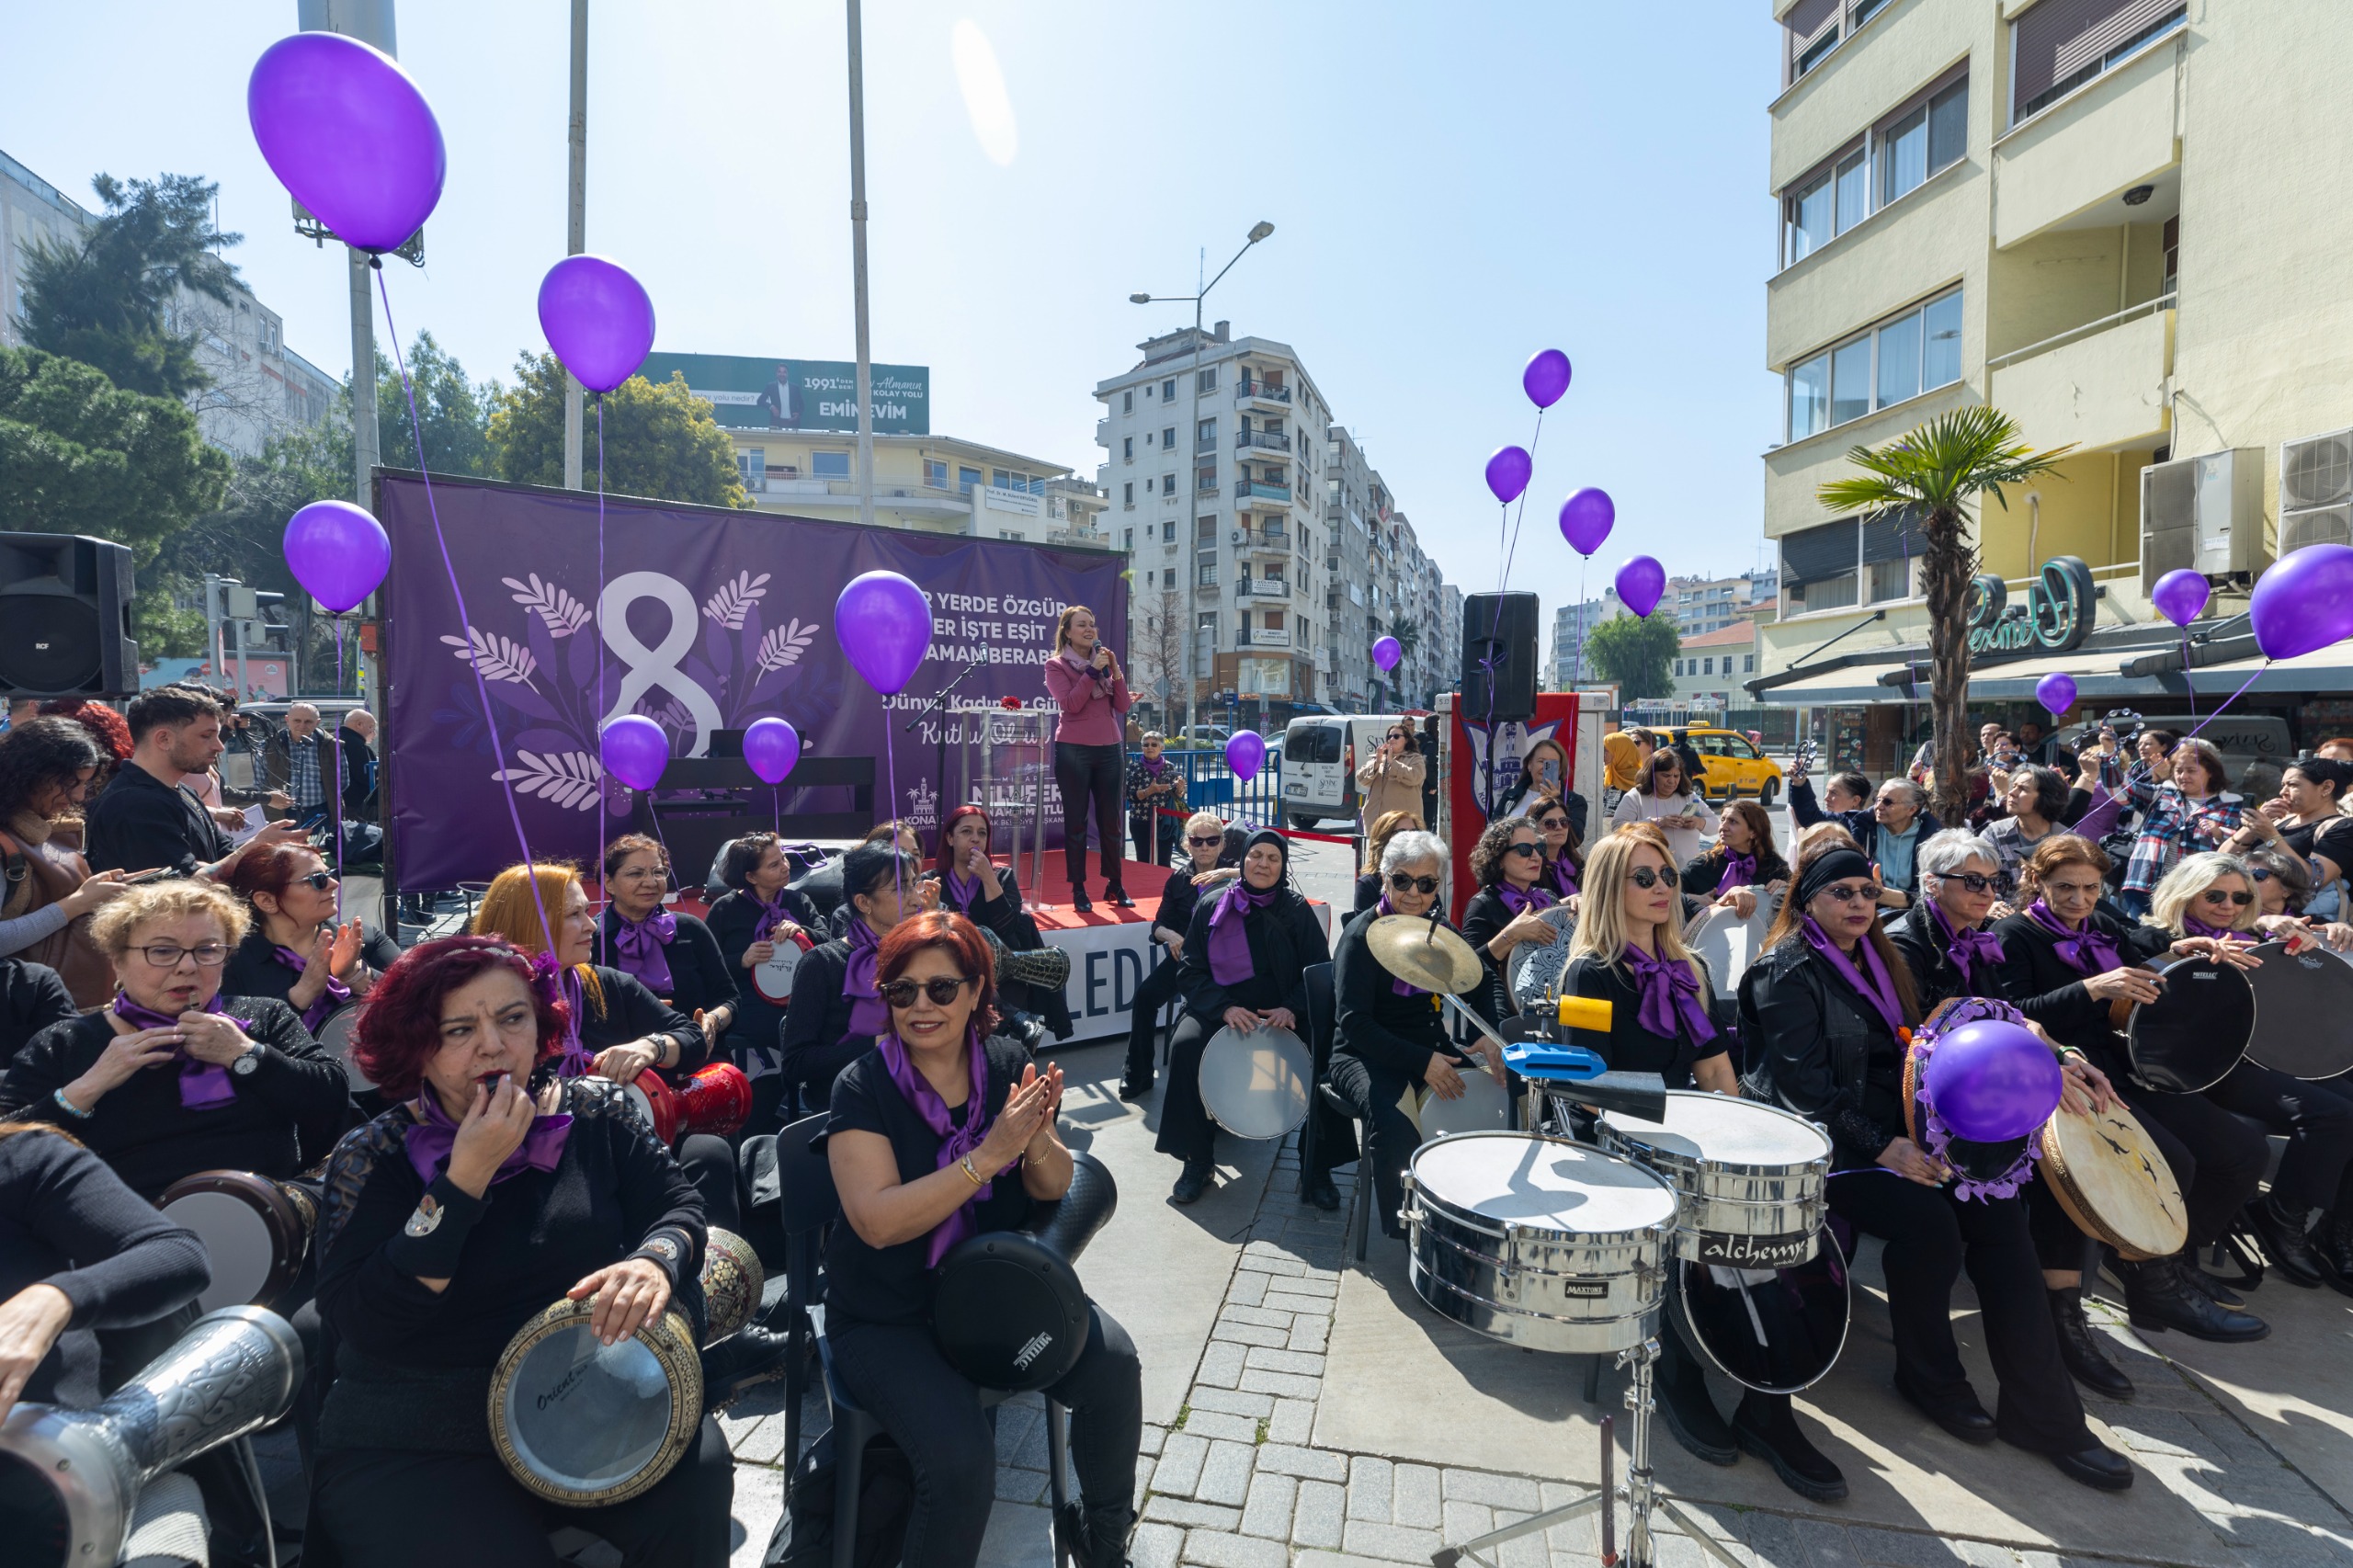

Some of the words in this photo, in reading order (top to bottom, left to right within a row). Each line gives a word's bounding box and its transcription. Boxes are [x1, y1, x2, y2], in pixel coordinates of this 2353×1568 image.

[877, 376, 923, 392] Almanın
[902, 391, 923, 399] YOLU
[713, 393, 730, 403] yolu
[732, 394, 755, 403] nedir?
[937, 593, 998, 614] YERDE
[1003, 595, 1067, 618] ÖZGÜR
[933, 618, 957, 637] ER
[961, 616, 1003, 642] İŞTE
[1007, 619, 1047, 643] EŞİT
[924, 643, 983, 663] AMAN
[1704, 1234, 1805, 1267] alchemy
[1566, 1286, 1603, 1295] MAXTONE
[1019, 1333, 1052, 1368] MITELLO
[537, 1370, 575, 1412] Orient
